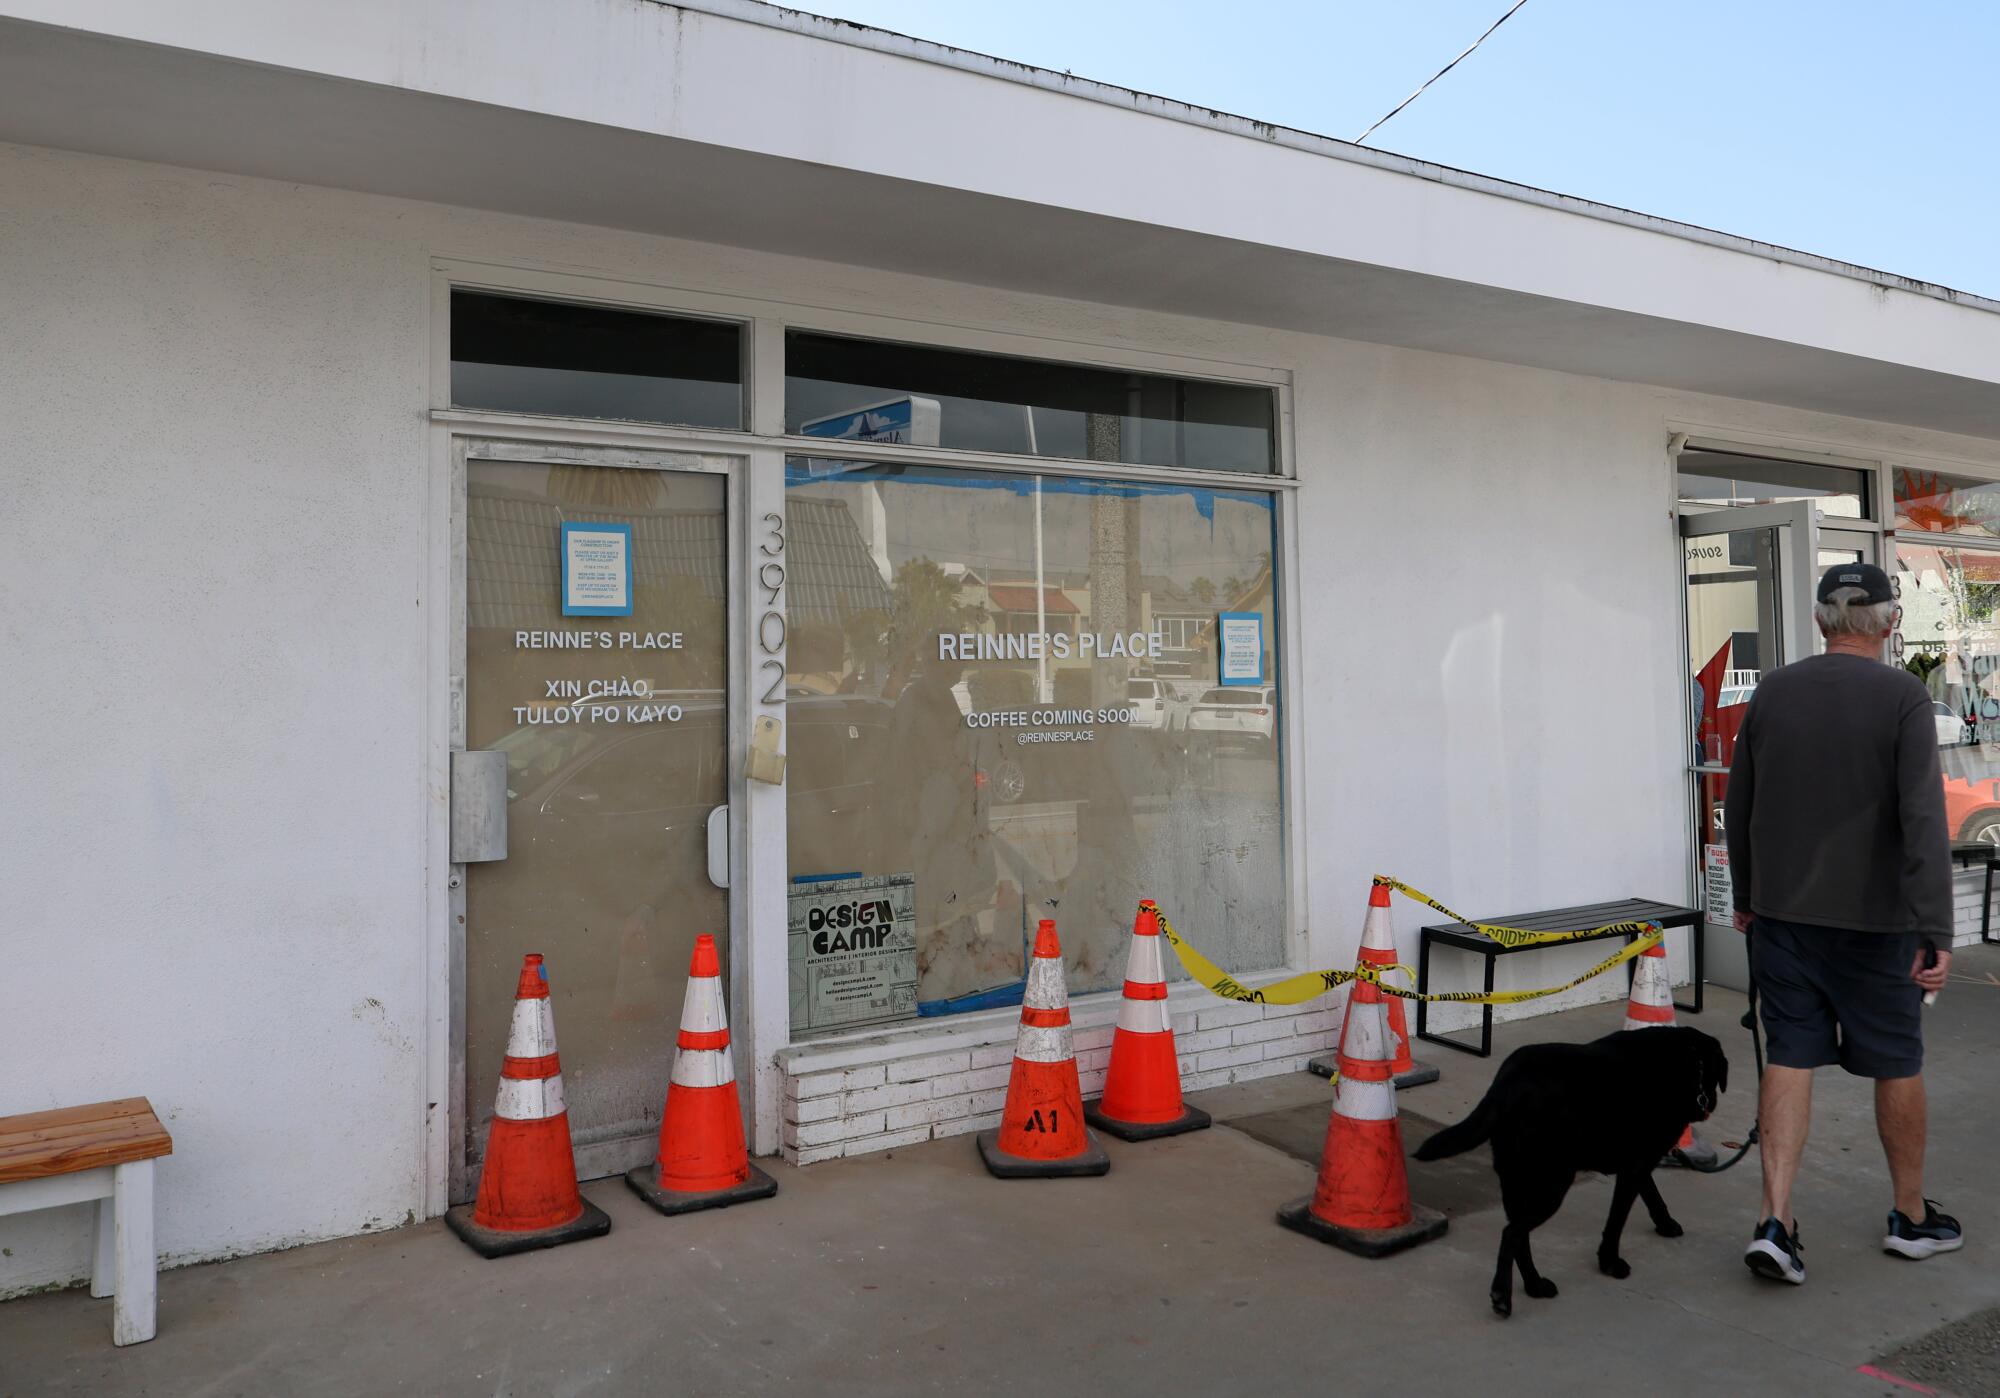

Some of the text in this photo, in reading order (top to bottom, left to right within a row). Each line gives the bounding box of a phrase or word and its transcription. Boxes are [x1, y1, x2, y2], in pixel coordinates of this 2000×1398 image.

[759, 512, 787, 704] 3902
[515, 631, 684, 650] REINNE'S PLACE
[937, 631, 1163, 660] REINNE'S PLACE
[545, 676, 654, 700] XIN CHÀO,
[512, 705, 682, 725] TULOY PO KAYO
[966, 707, 1140, 728] COFFEE COMING SOON
[1017, 730, 1094, 745] @REINNESPLACE
[807, 954, 847, 965] ARCHITECTURE
[852, 951, 877, 960] INTERIOR
[1023, 1109, 1058, 1133] A1
